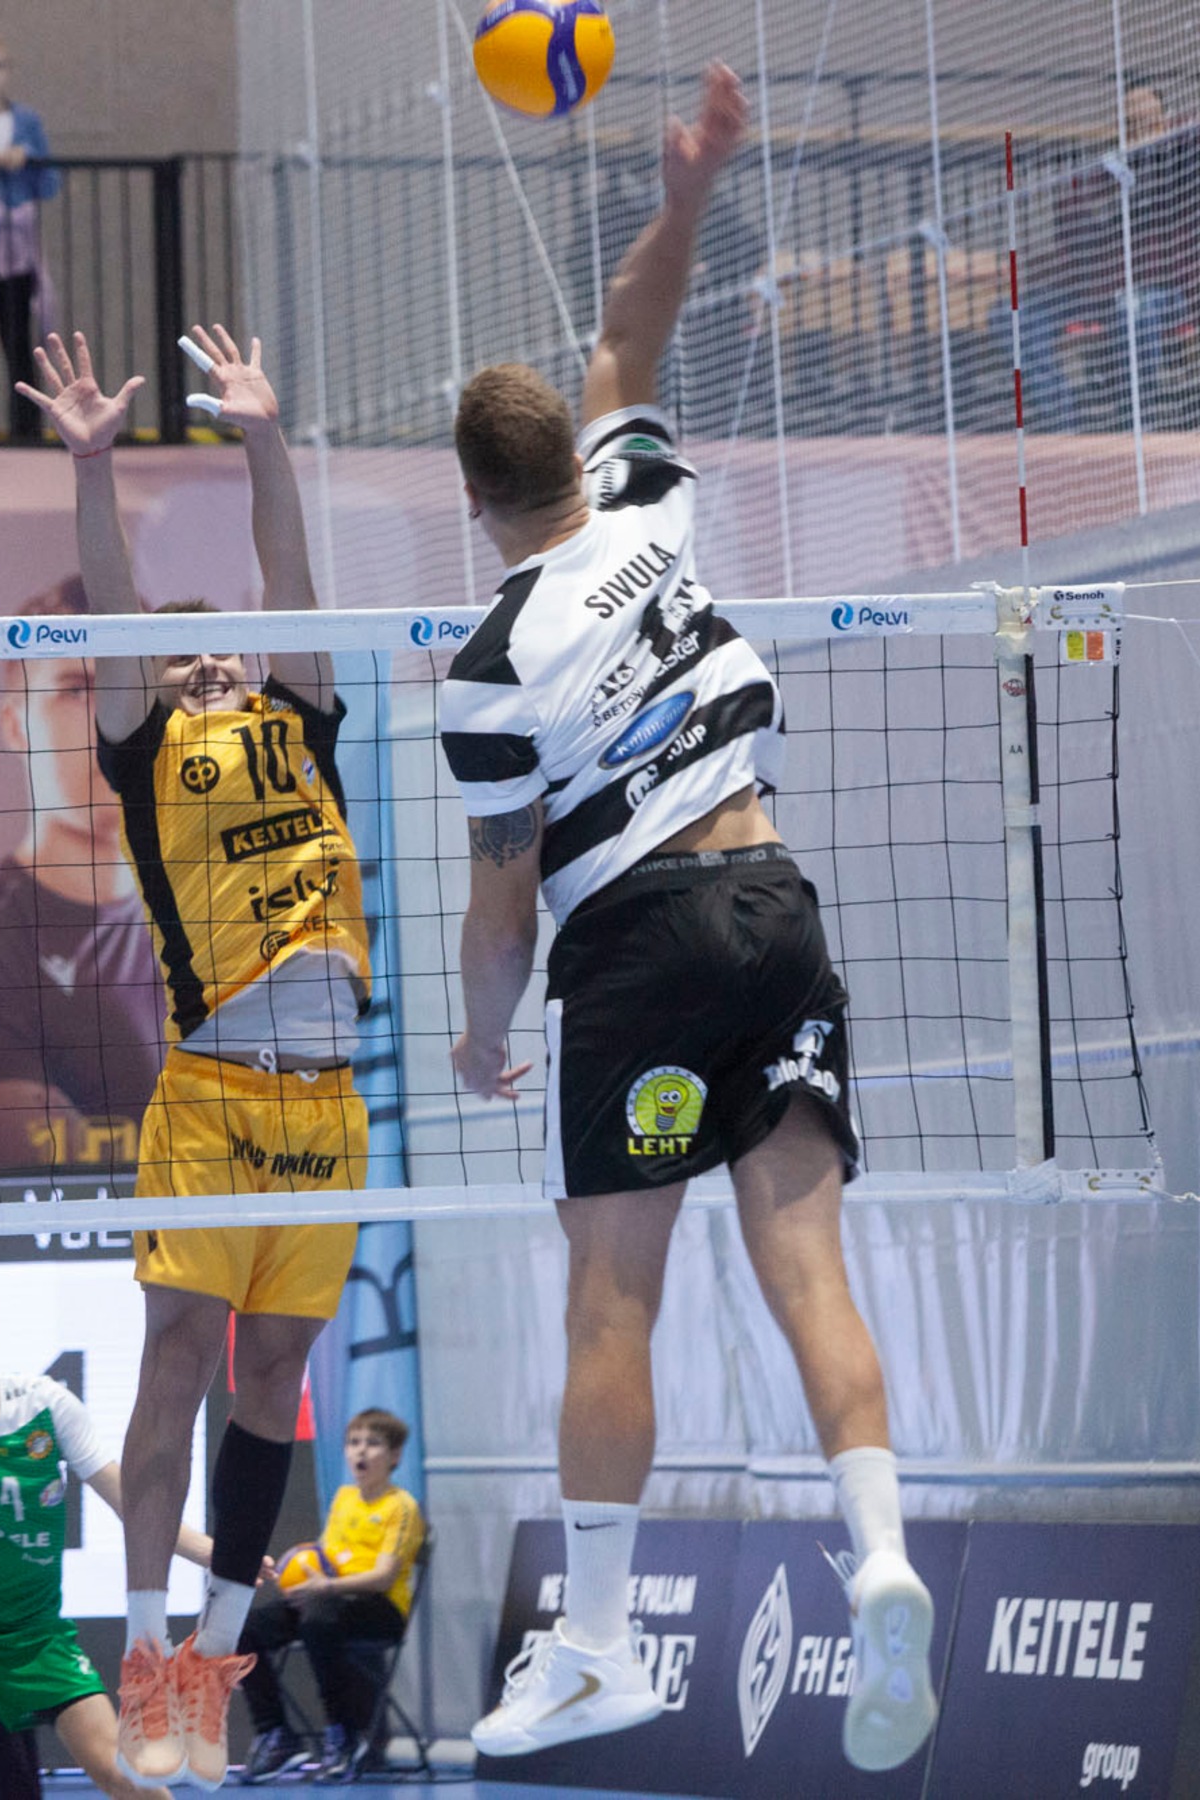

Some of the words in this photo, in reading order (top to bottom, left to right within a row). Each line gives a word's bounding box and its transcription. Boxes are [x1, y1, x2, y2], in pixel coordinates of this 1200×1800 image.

[584, 541, 677, 619] SIVULA
[1066, 591, 1104, 601] Senoh
[231, 720, 295, 800] 10
[985, 1597, 1153, 1680] KEITELE
[1079, 1741, 1140, 1791] group
